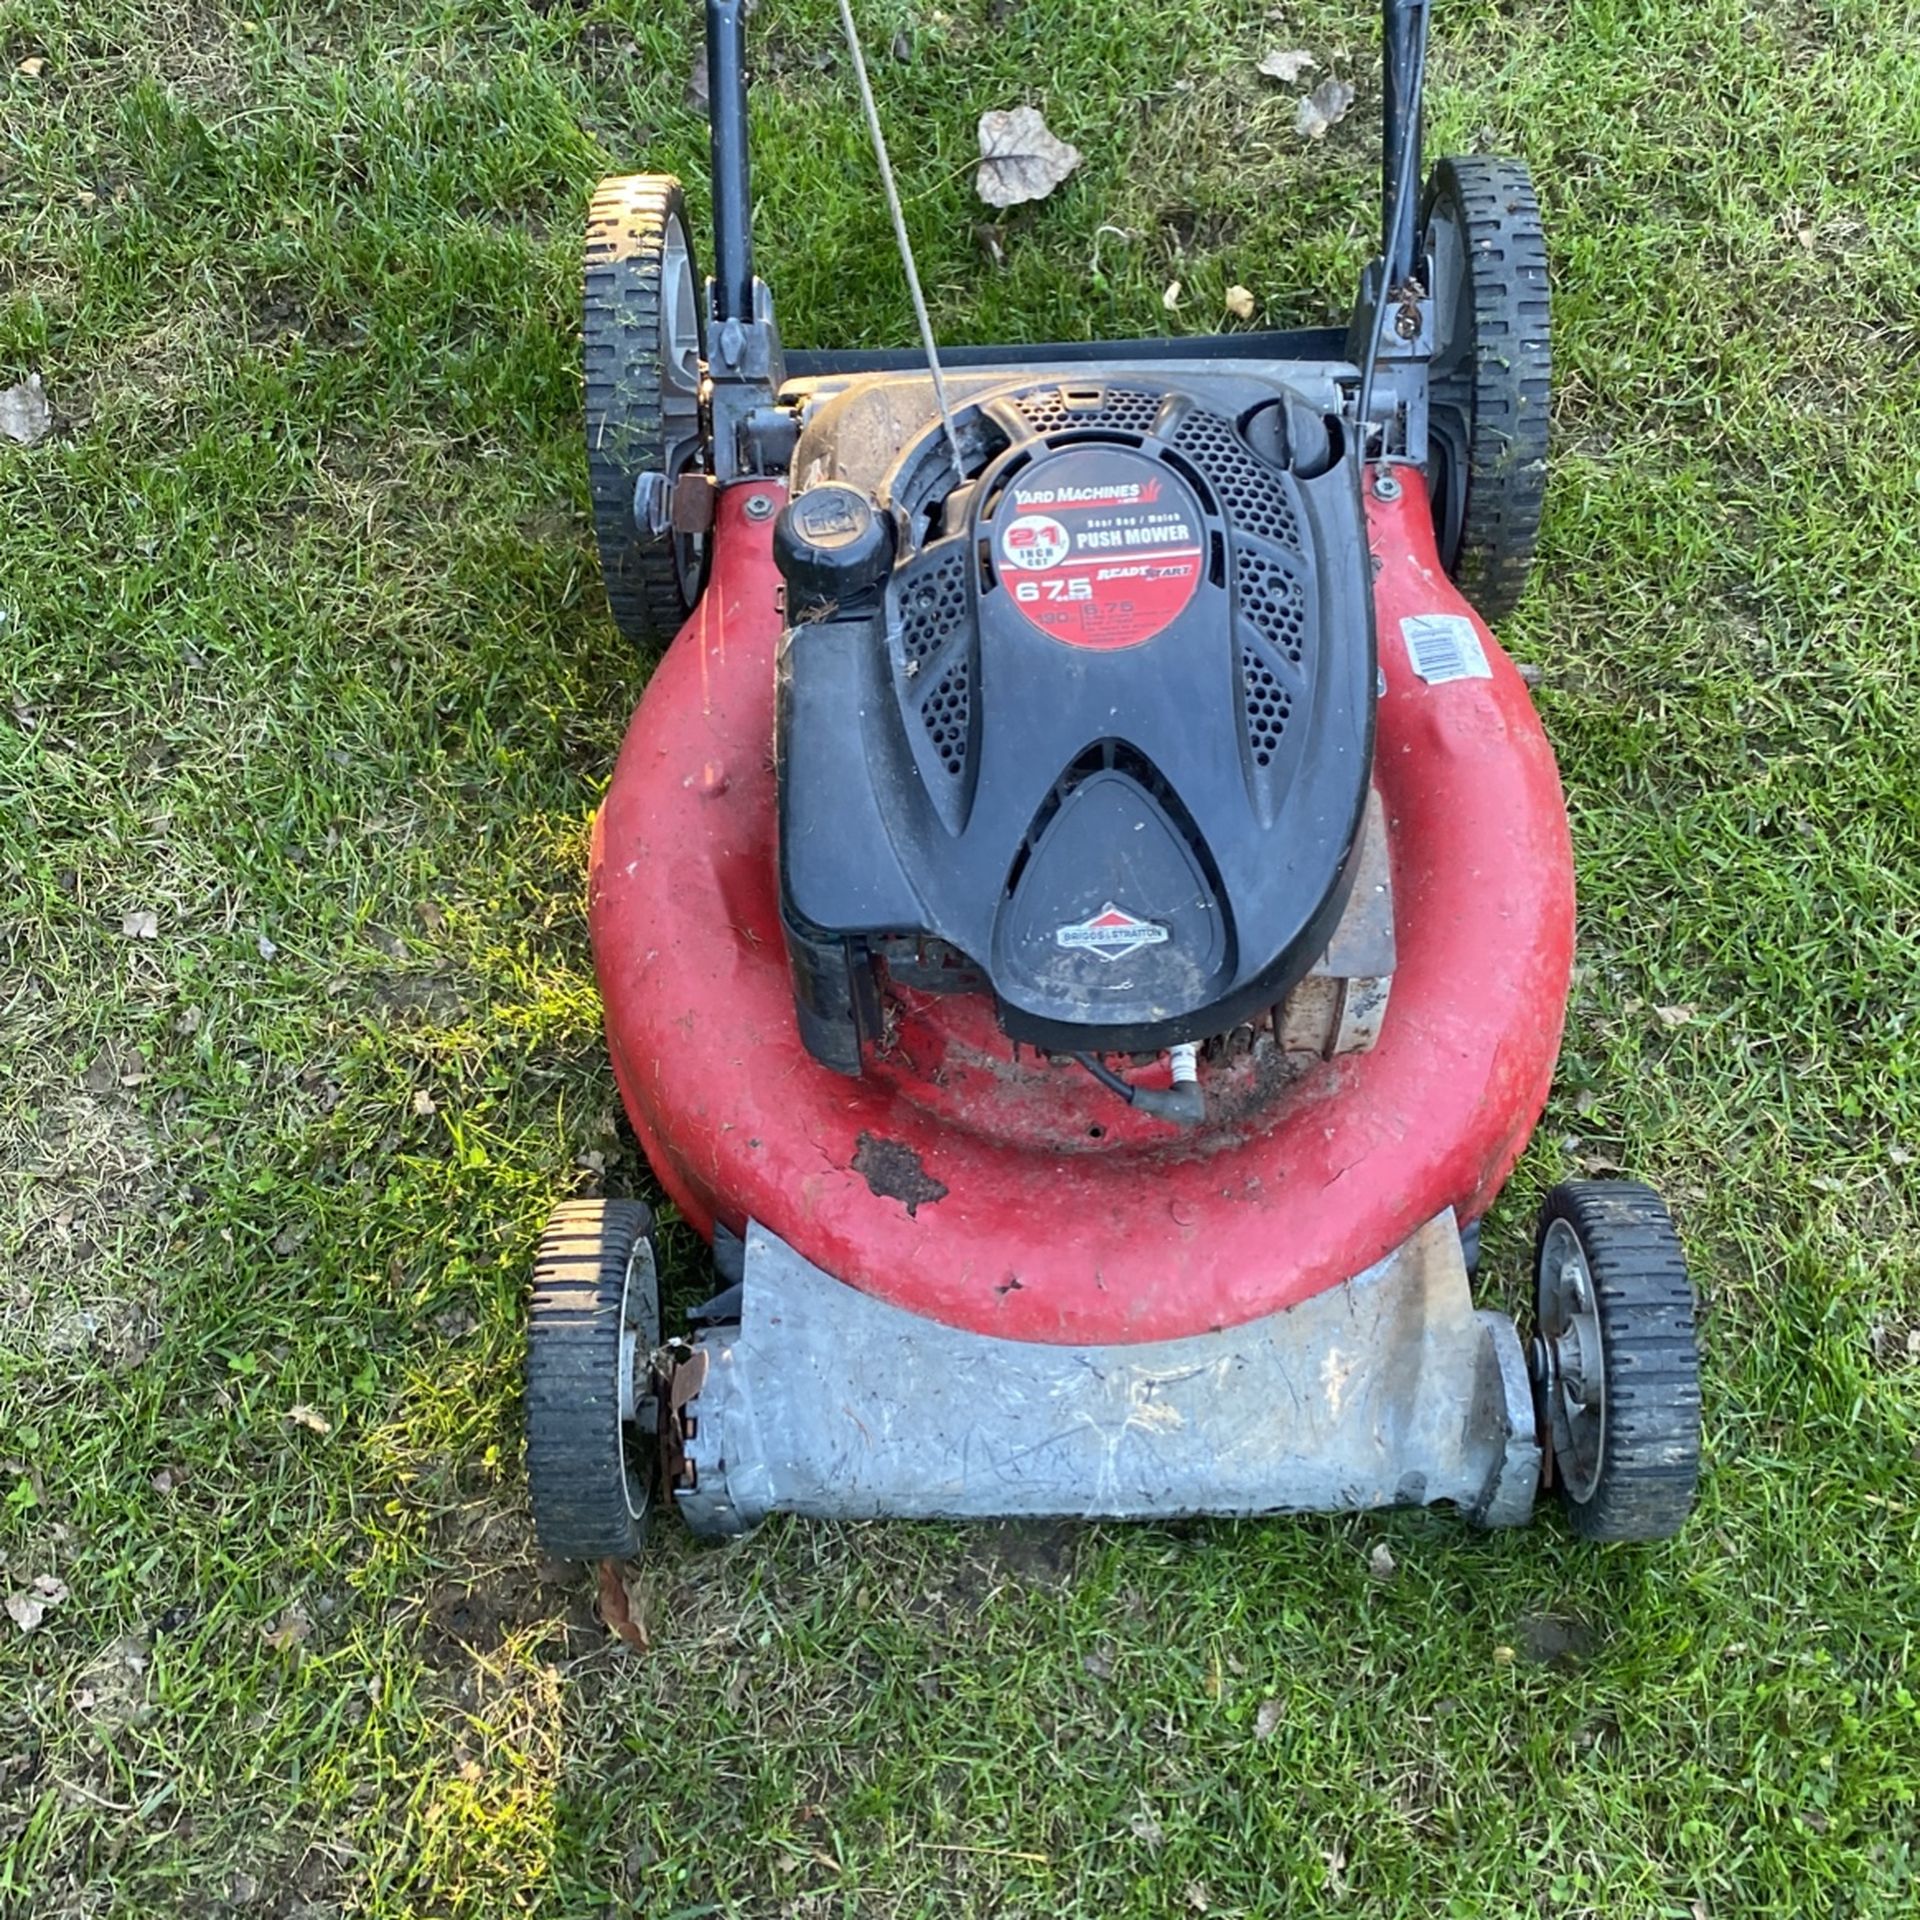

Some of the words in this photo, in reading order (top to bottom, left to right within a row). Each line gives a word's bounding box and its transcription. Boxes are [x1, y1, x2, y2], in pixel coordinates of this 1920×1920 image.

[1014, 489, 1055, 505] YARD
[1057, 483, 1140, 502] MACHINES
[1008, 526, 1060, 548] 21
[1076, 531, 1123, 549] PUSH
[1125, 525, 1190, 544] MOWER
[1020, 548, 1054, 559] INCH
[1015, 577, 1093, 602] 675
